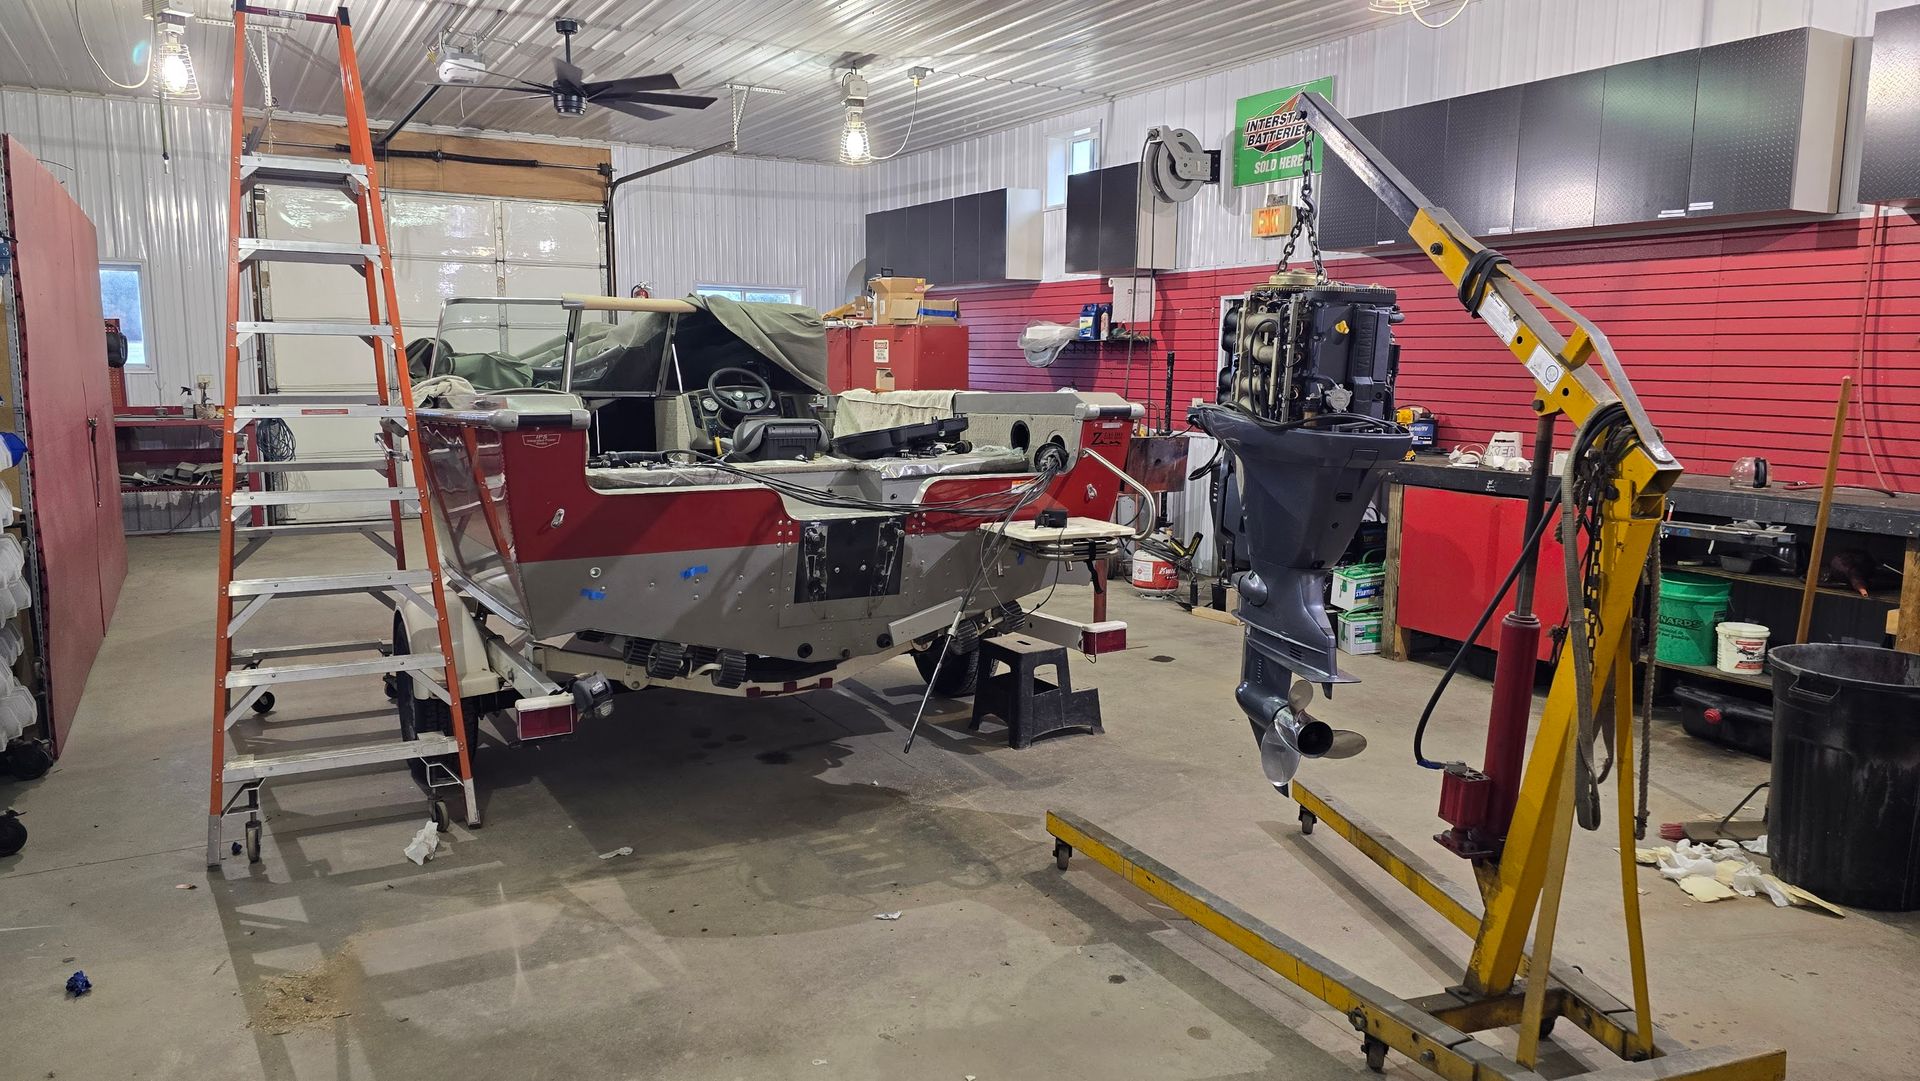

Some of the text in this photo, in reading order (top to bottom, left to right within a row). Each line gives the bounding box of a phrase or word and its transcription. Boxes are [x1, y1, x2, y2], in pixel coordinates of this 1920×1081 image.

[1246, 111, 1305, 132] INTERST
[1254, 154, 1304, 174] SOLD HERE
[1257, 208, 1280, 234] EXIT
